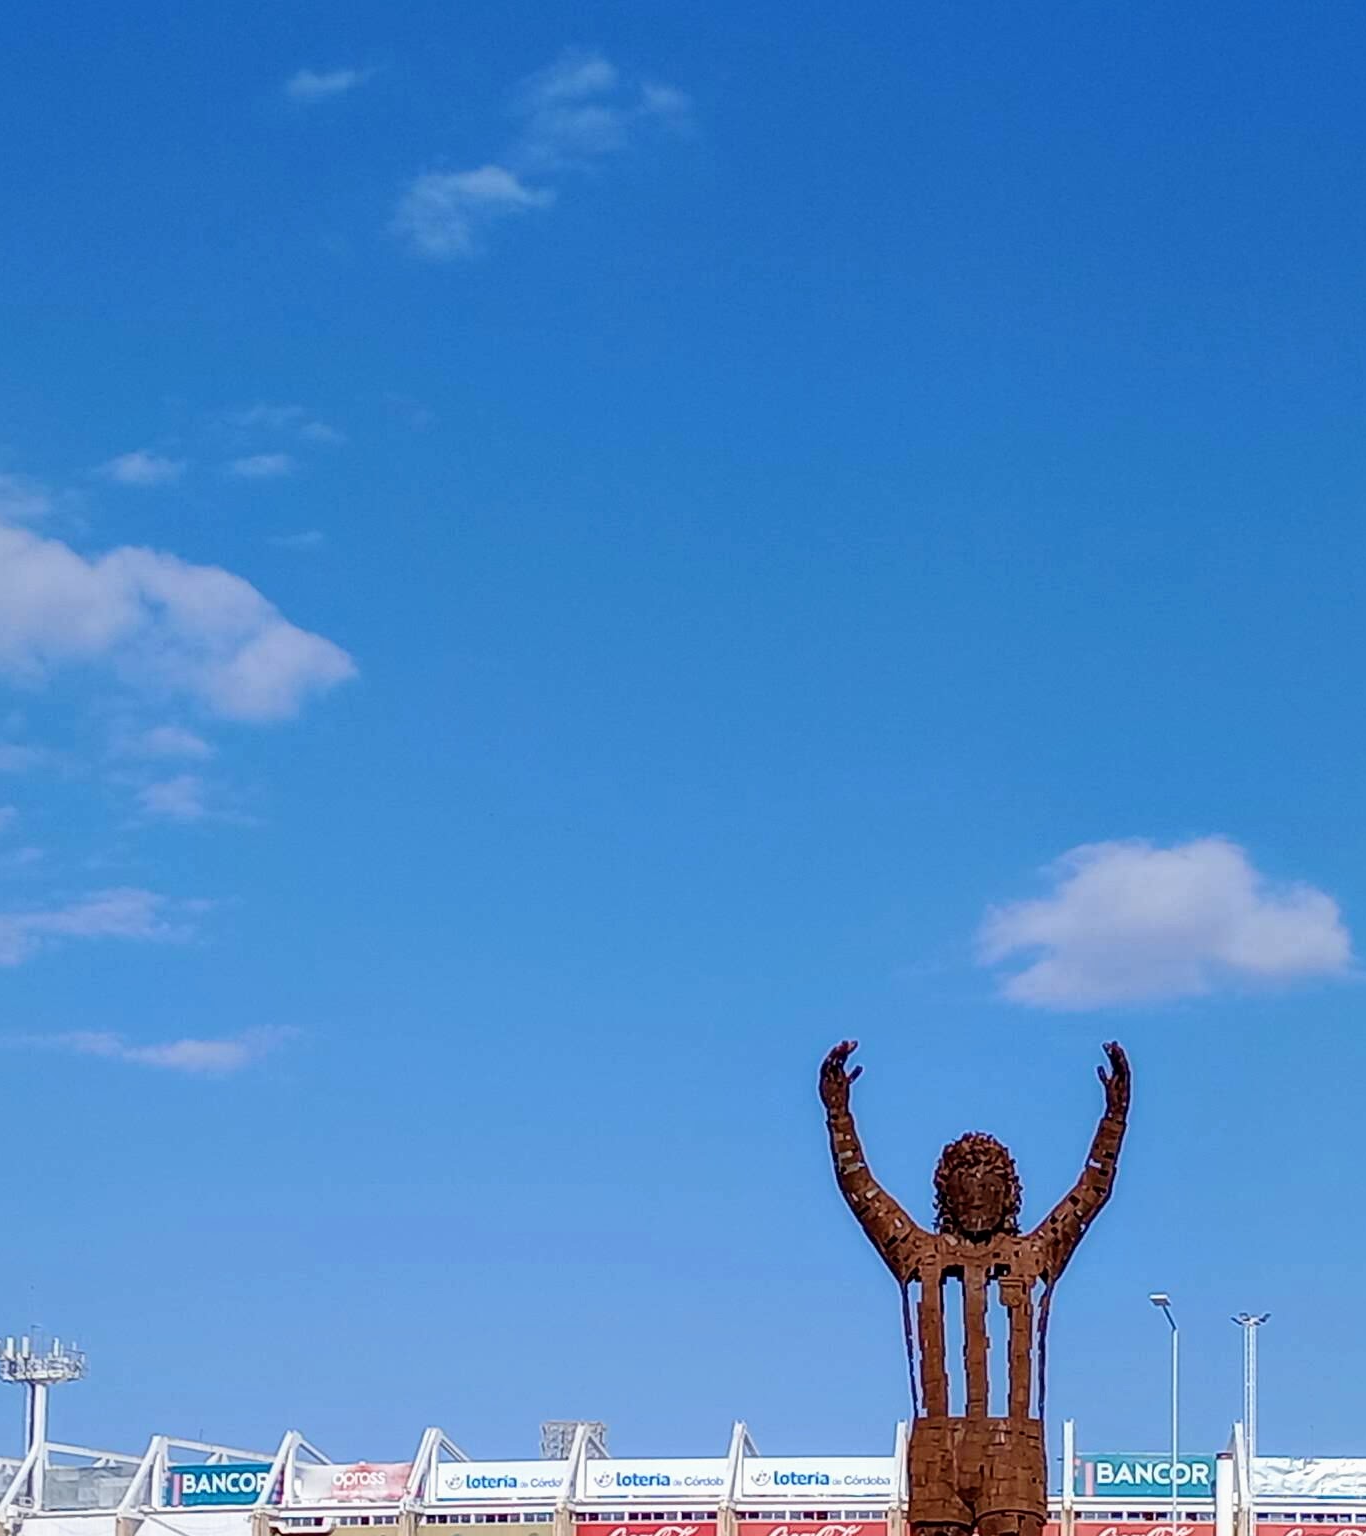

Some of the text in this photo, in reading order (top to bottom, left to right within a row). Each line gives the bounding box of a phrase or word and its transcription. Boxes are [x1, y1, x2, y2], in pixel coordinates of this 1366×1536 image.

[1096, 1462, 1209, 1485] BANCOR
[530, 1477, 564, 1488] Córdo
[684, 1475, 724, 1486] Córdob
[844, 1474, 891, 1485] Córdoba
